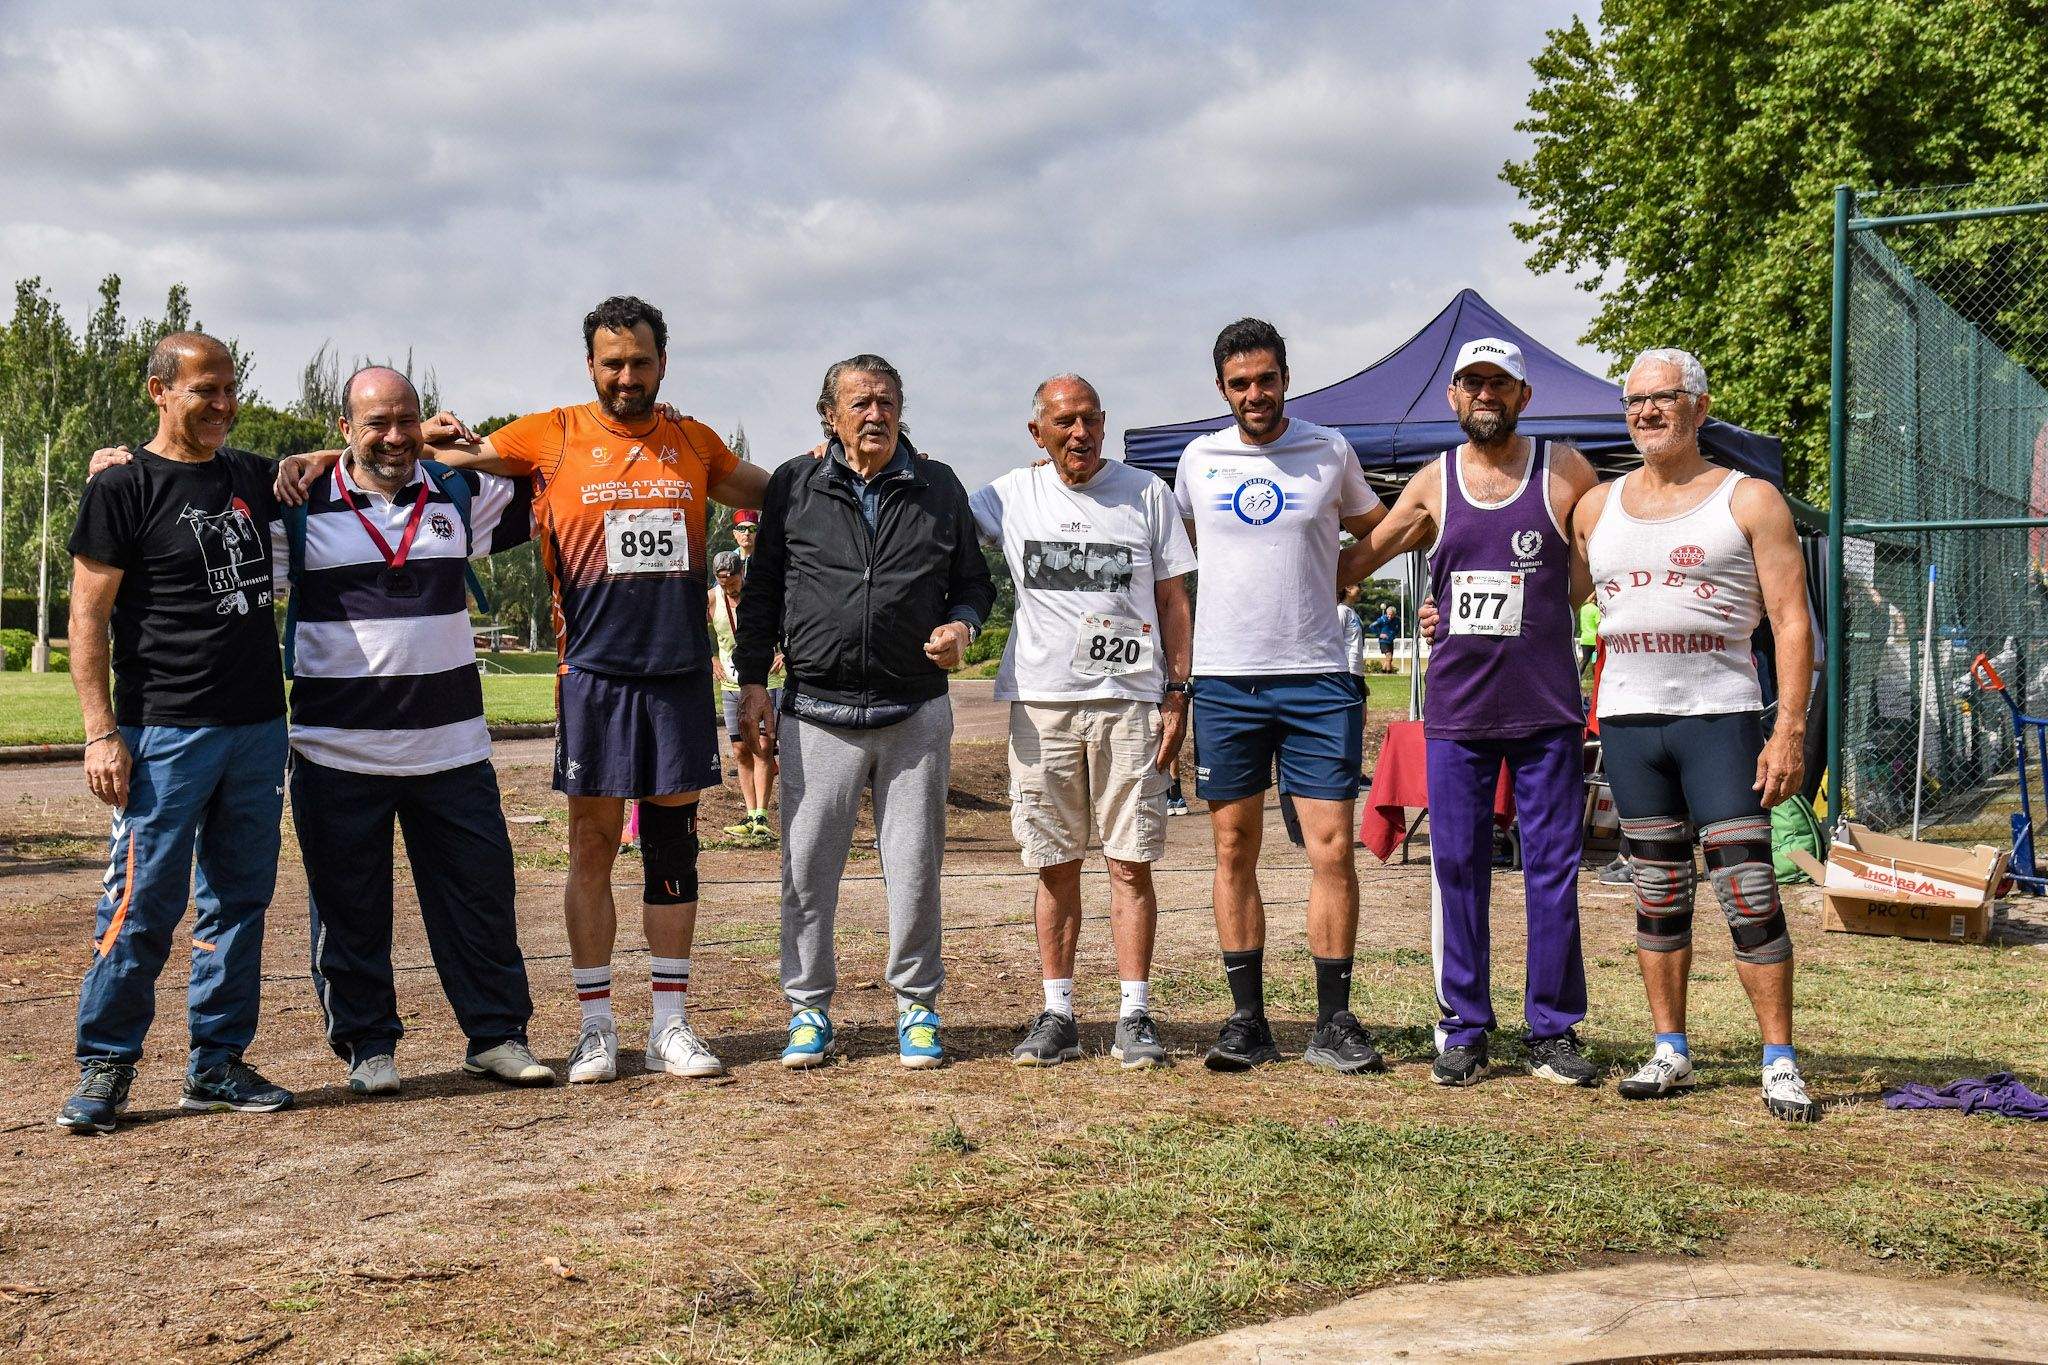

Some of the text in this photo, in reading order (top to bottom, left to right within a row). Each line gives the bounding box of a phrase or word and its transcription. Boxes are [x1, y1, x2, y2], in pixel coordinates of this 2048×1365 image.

[581, 478, 693, 493] UNIÓN ATLÉTICA
[581, 486, 694, 505] COSLADA
[621, 530, 673, 558] 895
[1459, 592, 1508, 619] 877
[1089, 635, 1140, 665] 820
[1771, 1072, 1798, 1083] NIKE
